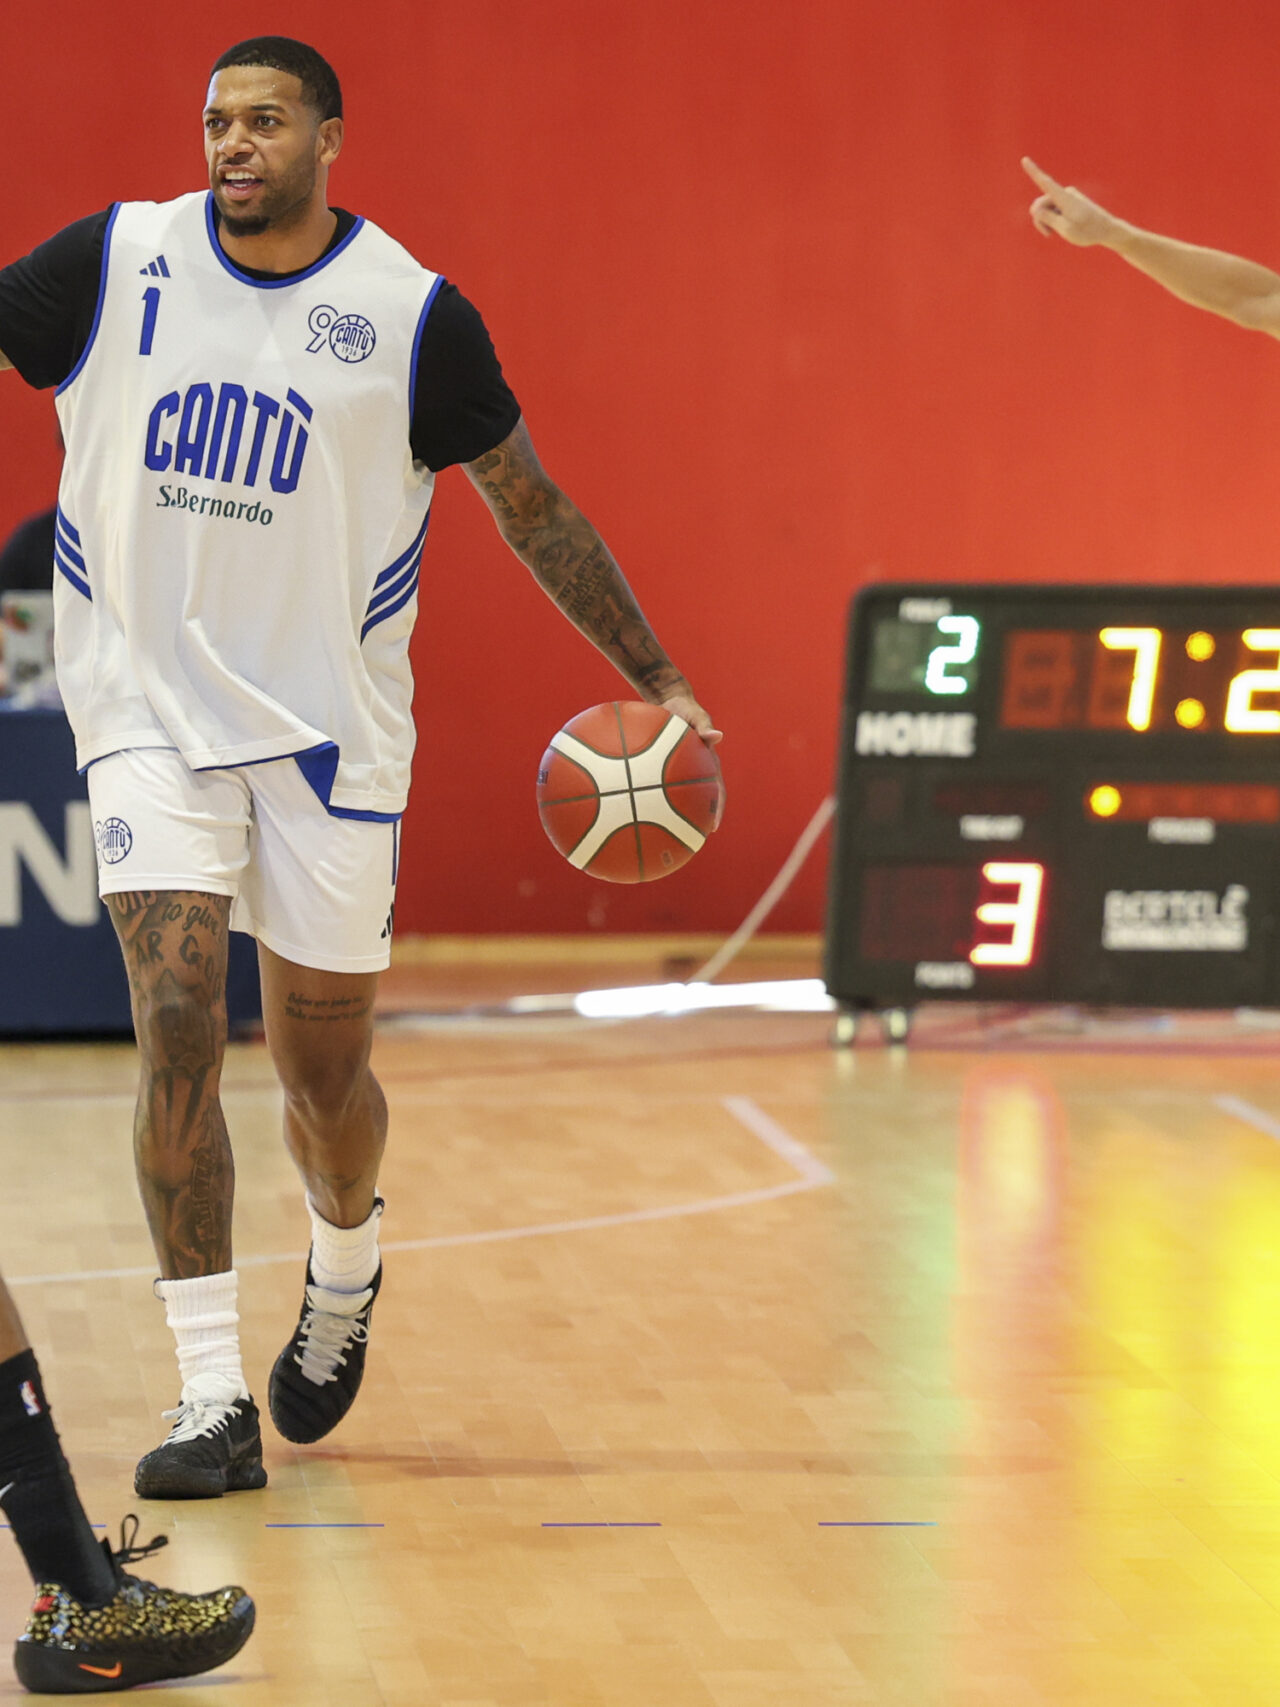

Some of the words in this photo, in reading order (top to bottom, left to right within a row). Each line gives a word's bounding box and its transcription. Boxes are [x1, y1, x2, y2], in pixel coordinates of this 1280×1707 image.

[139, 286, 161, 356] 1
[144, 382, 313, 494] CANTÙ
[925, 616, 980, 694] 2
[855, 712, 976, 756] HOME
[970, 862, 1045, 965] 3
